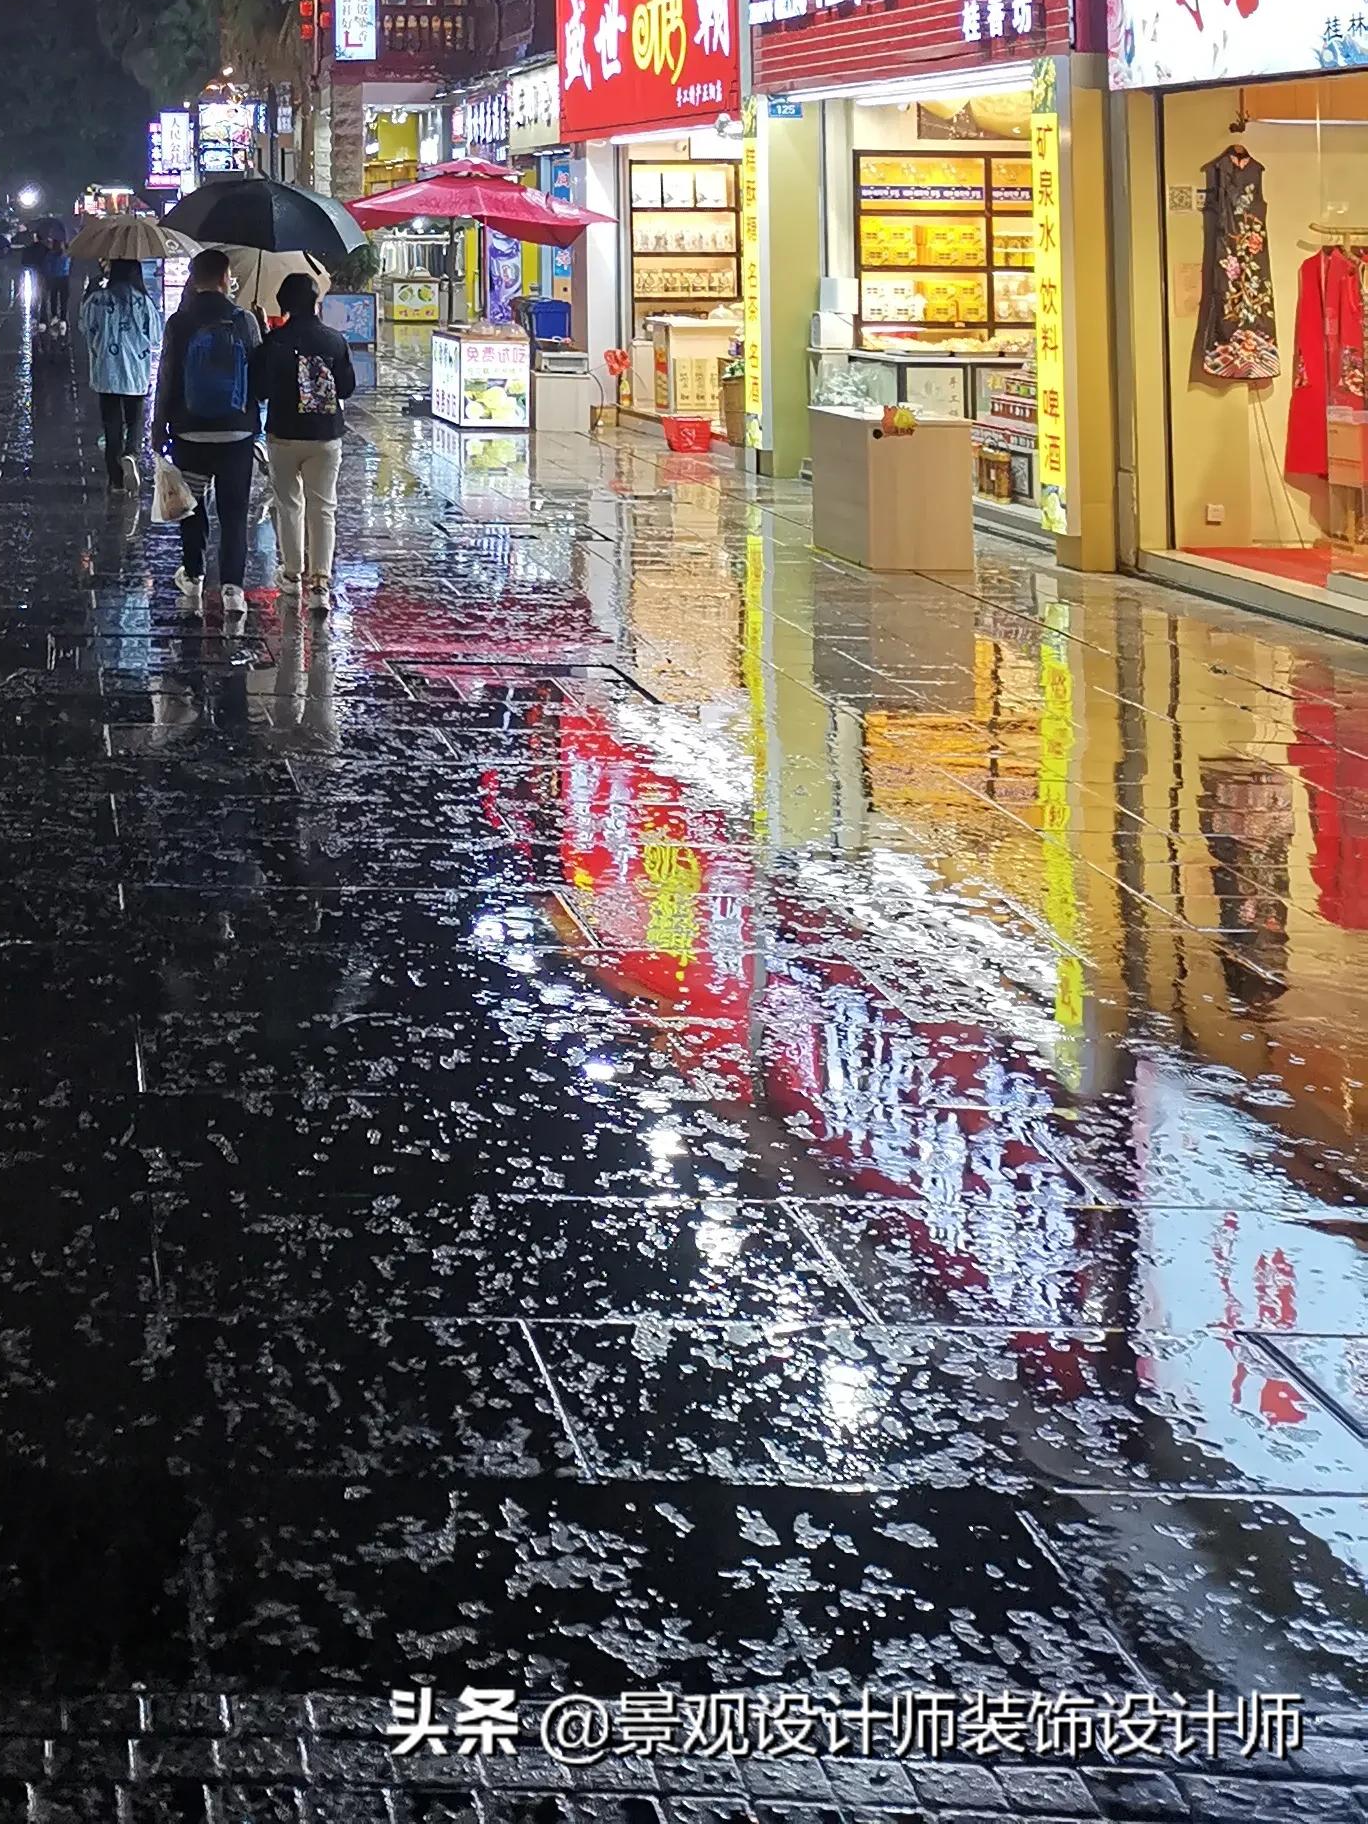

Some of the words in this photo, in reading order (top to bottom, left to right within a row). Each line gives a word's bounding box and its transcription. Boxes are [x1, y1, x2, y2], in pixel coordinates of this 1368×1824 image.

[776, 104, 796, 115] 125
[1035, 124, 1056, 253] 矿泉水
[466, 346, 526, 364] 免费试吃
[1040, 276, 1059, 362] 饮料
[1043, 387, 1061, 473] 啤酒
